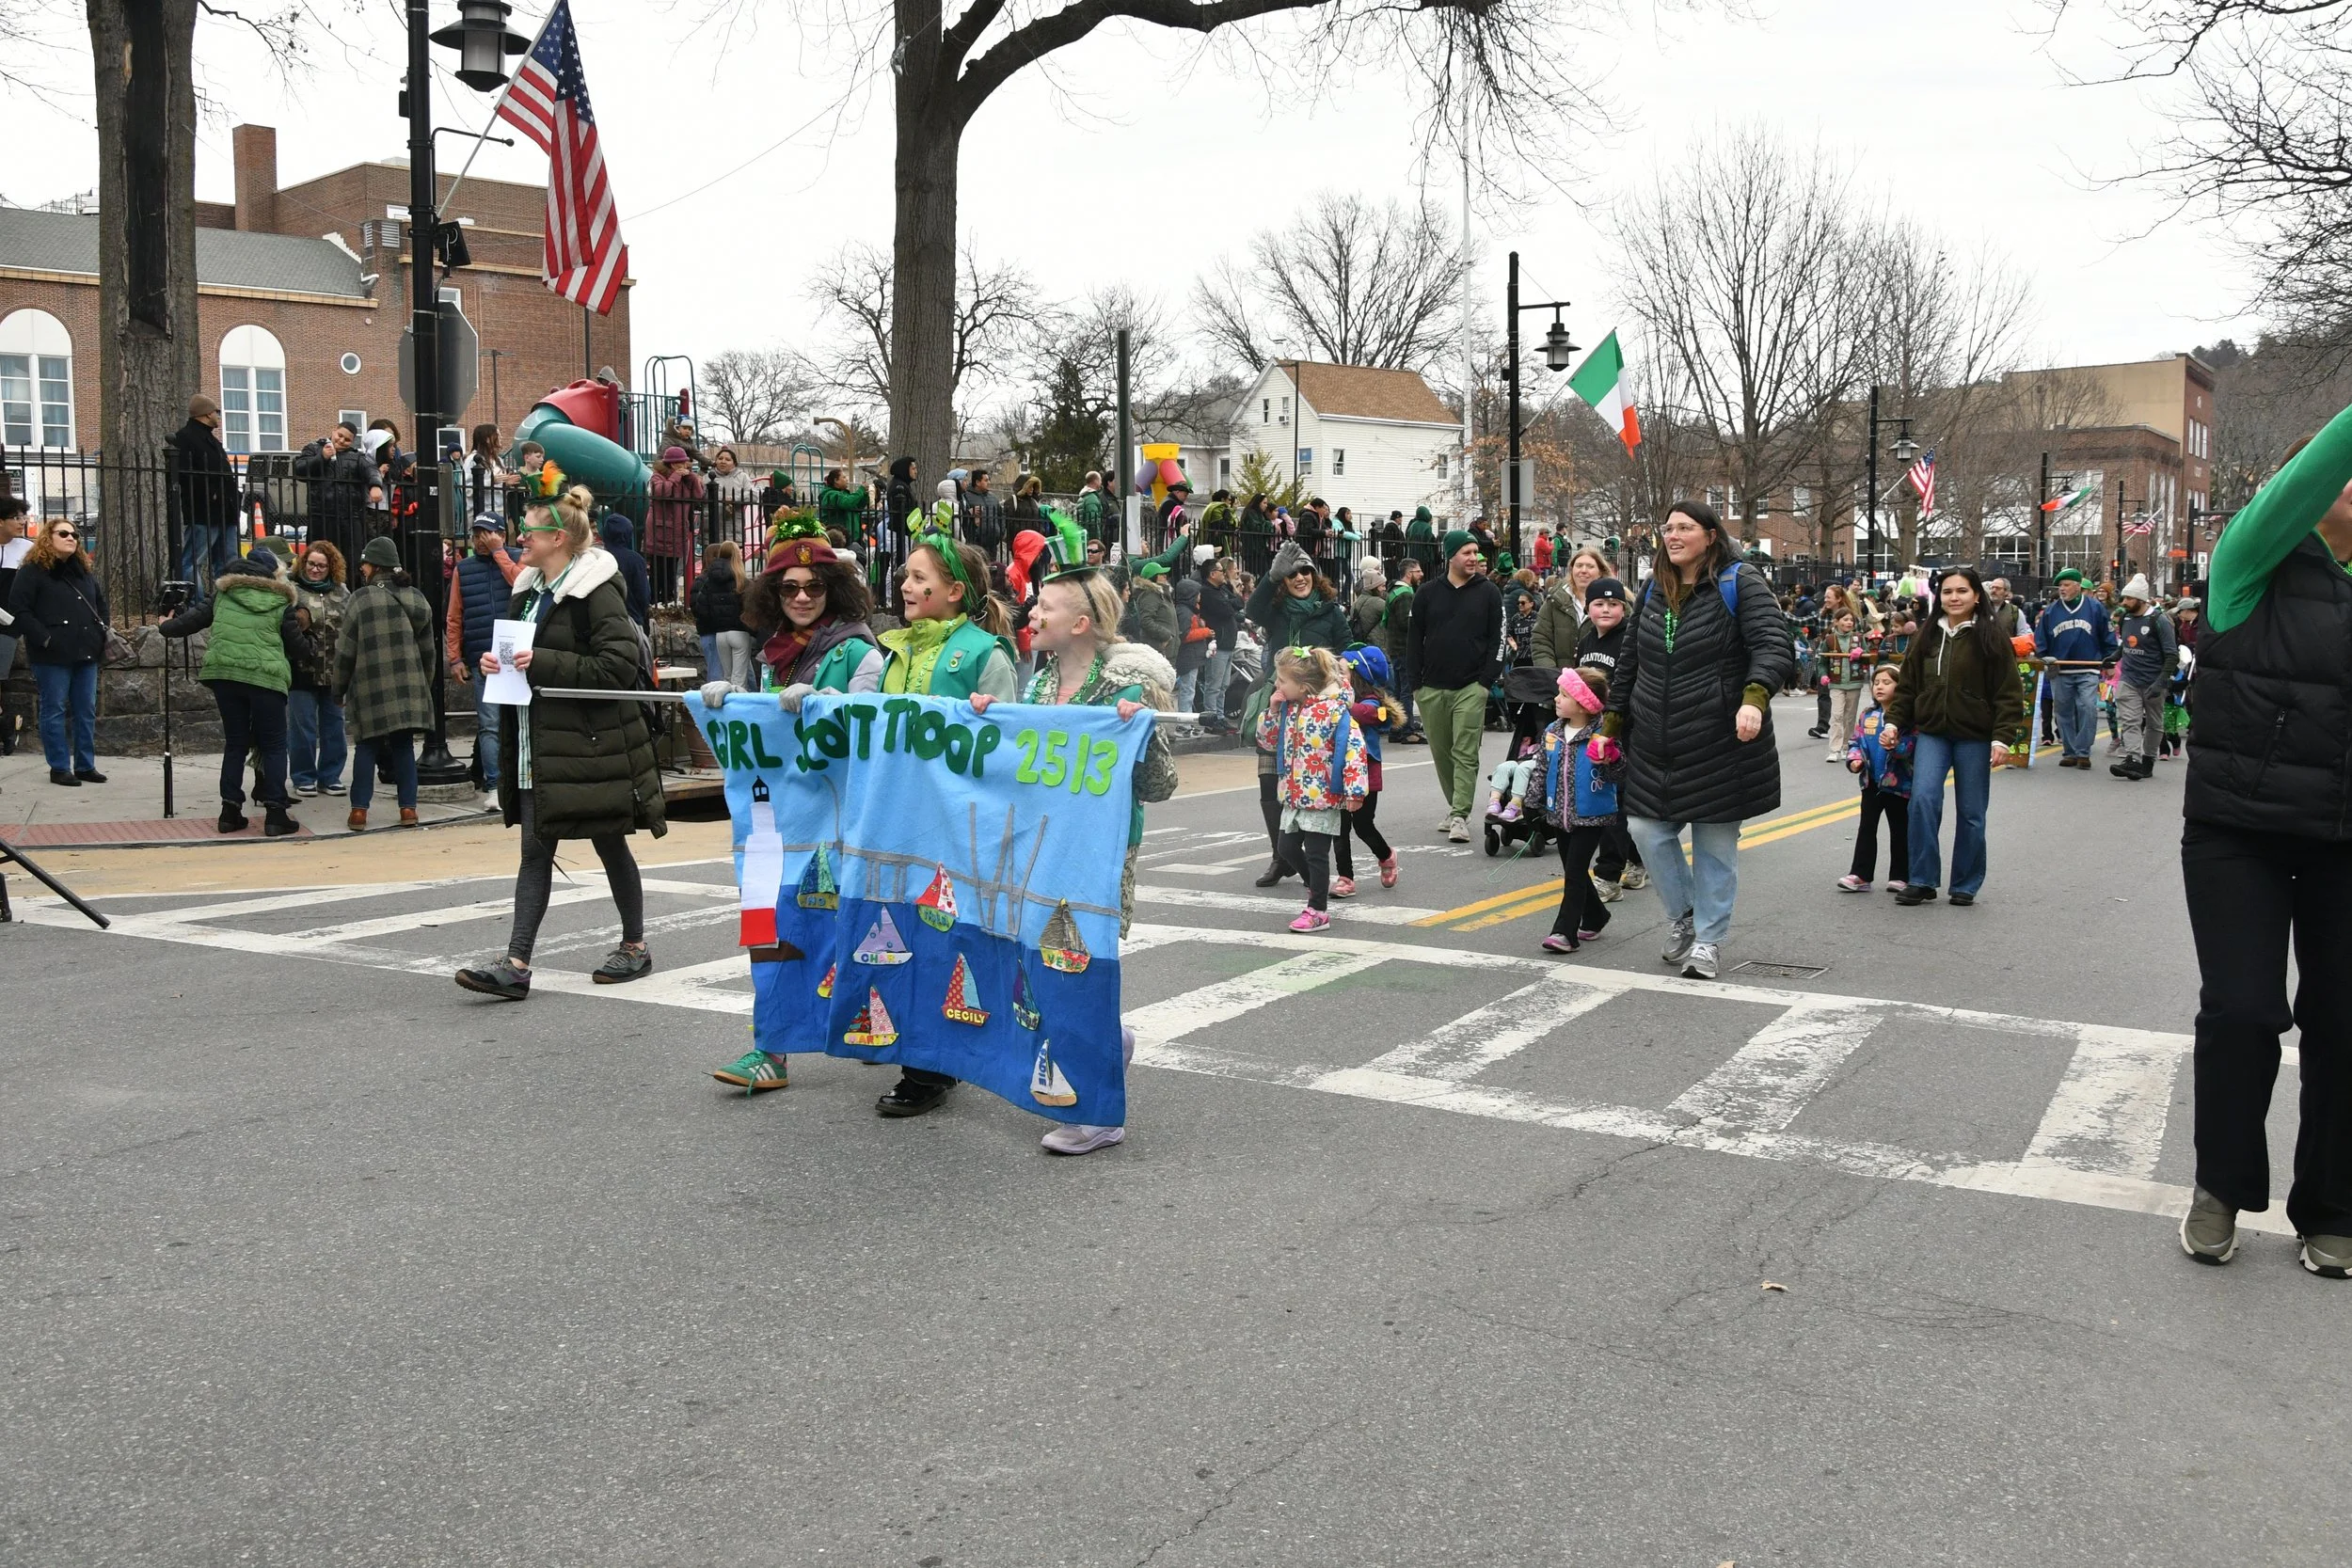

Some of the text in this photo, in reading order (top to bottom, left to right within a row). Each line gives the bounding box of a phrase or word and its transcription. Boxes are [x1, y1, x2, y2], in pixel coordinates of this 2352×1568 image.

[882, 698, 1001, 778] TROOP
[1015, 728, 1119, 796] 2513
[946, 1007, 986, 1024] CECILY
